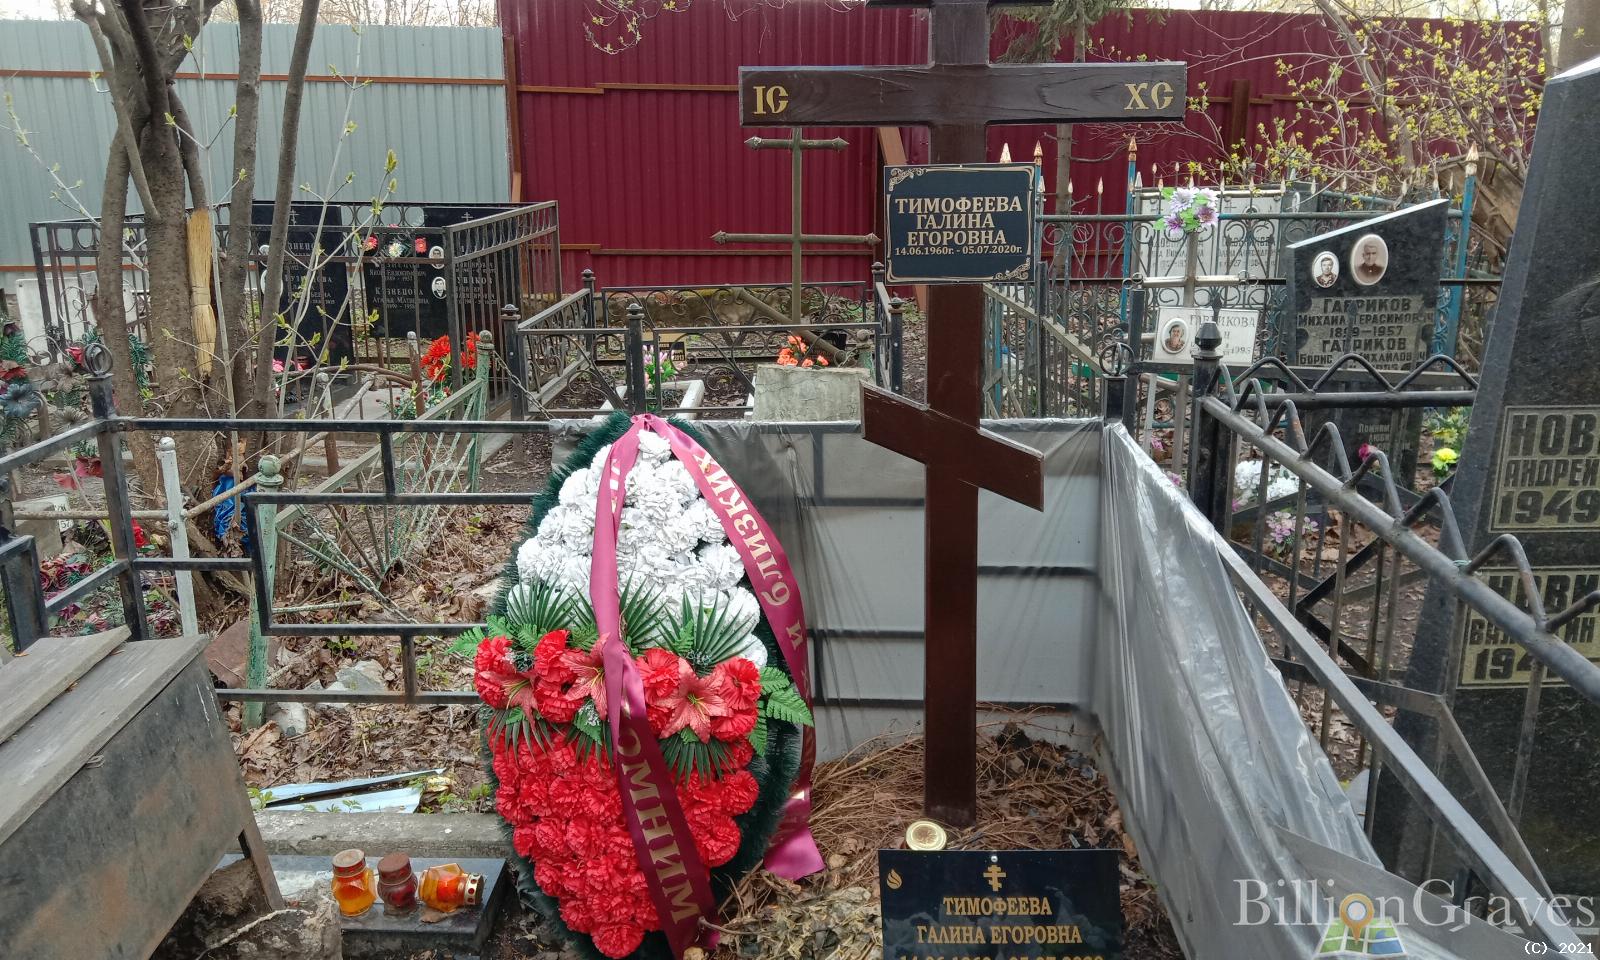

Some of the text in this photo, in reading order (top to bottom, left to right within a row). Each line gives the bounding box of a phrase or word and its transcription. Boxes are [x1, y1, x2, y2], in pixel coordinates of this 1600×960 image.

[895, 196, 1023, 214] ТИМОФЕЕВА
[916, 213, 995, 230] ГАЛИНА
[907, 230, 1007, 246] ЕГОРОВНА
[895, 246, 954, 256] 14.06.1960г.
[962, 245, 1023, 254] 05.07.2020г.
[1300, 354, 1333, 364] БОРИС
[943, 896, 1053, 916] ТИМОФЕЕВА
[916, 925, 1083, 945] ГАЛИНА ЕГОРОВНА
